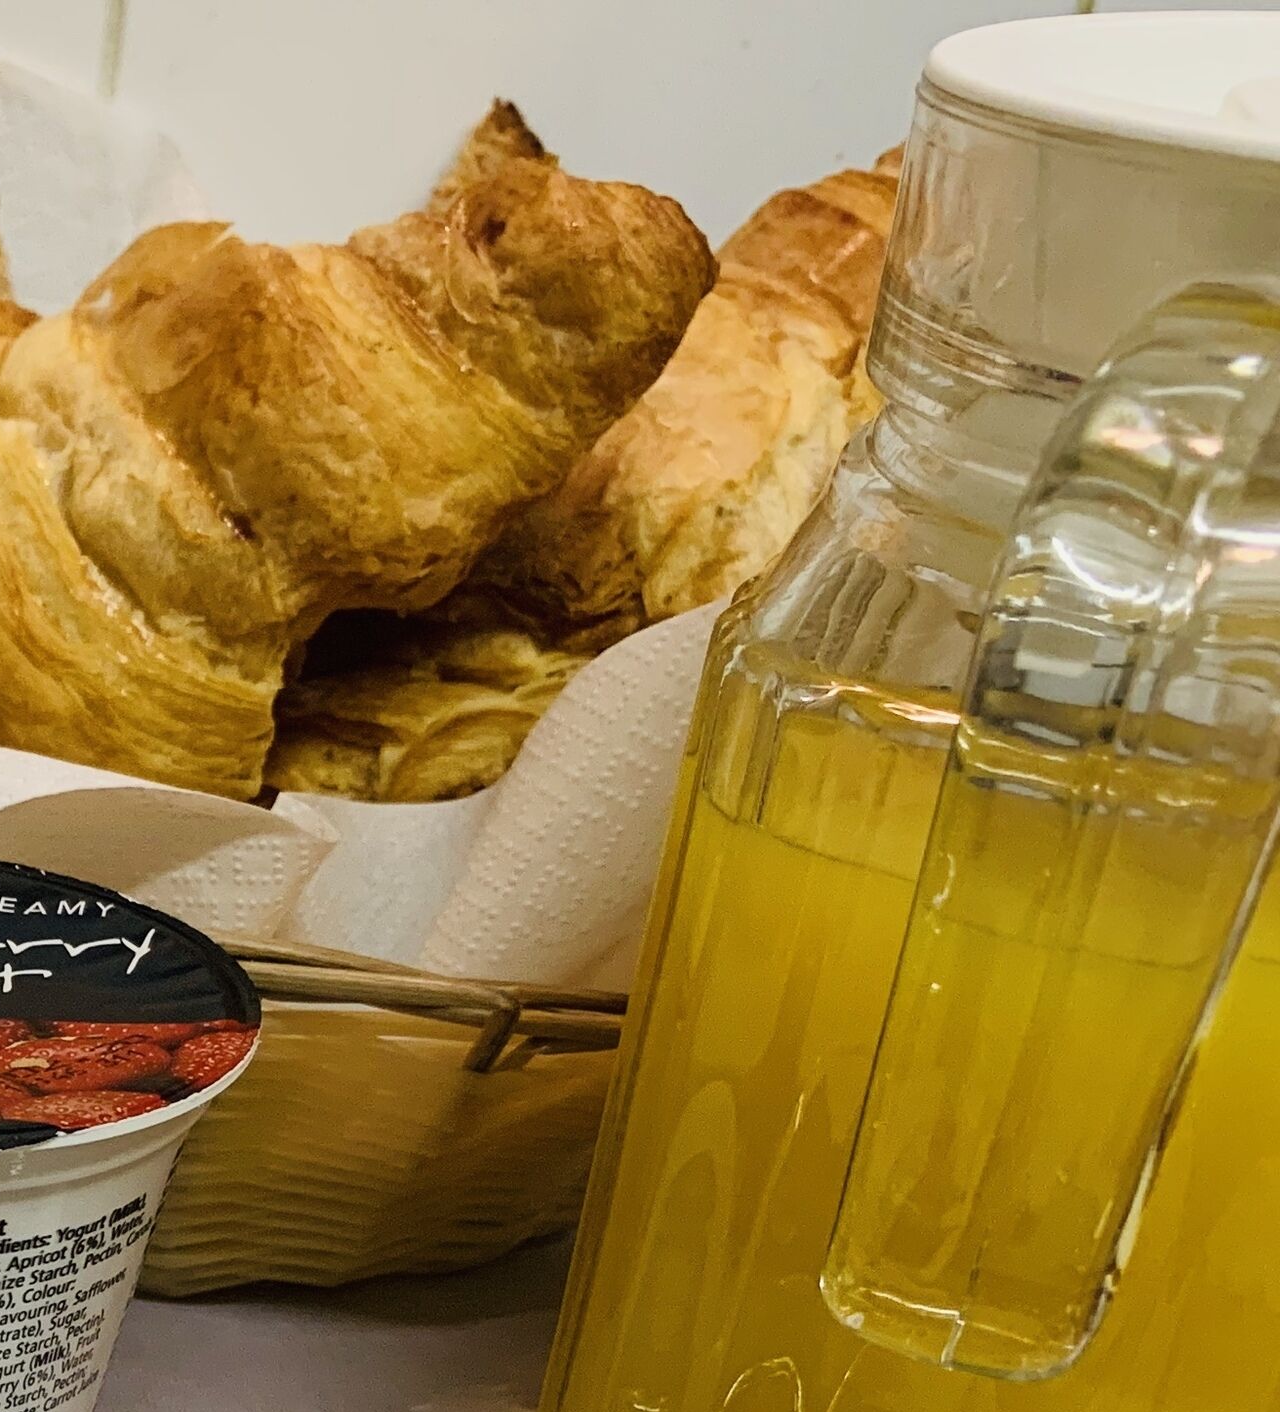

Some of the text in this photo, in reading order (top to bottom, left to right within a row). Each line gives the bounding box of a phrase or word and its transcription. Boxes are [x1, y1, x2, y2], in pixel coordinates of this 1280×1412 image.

[56, 1215, 107, 1243] Yogurt
[6, 1246, 68, 1273] Apricot
[29, 1259, 79, 1285] Starch,
[15, 1332, 62, 1358] Starch,
[4, 1385, 48, 1410] Starch,
